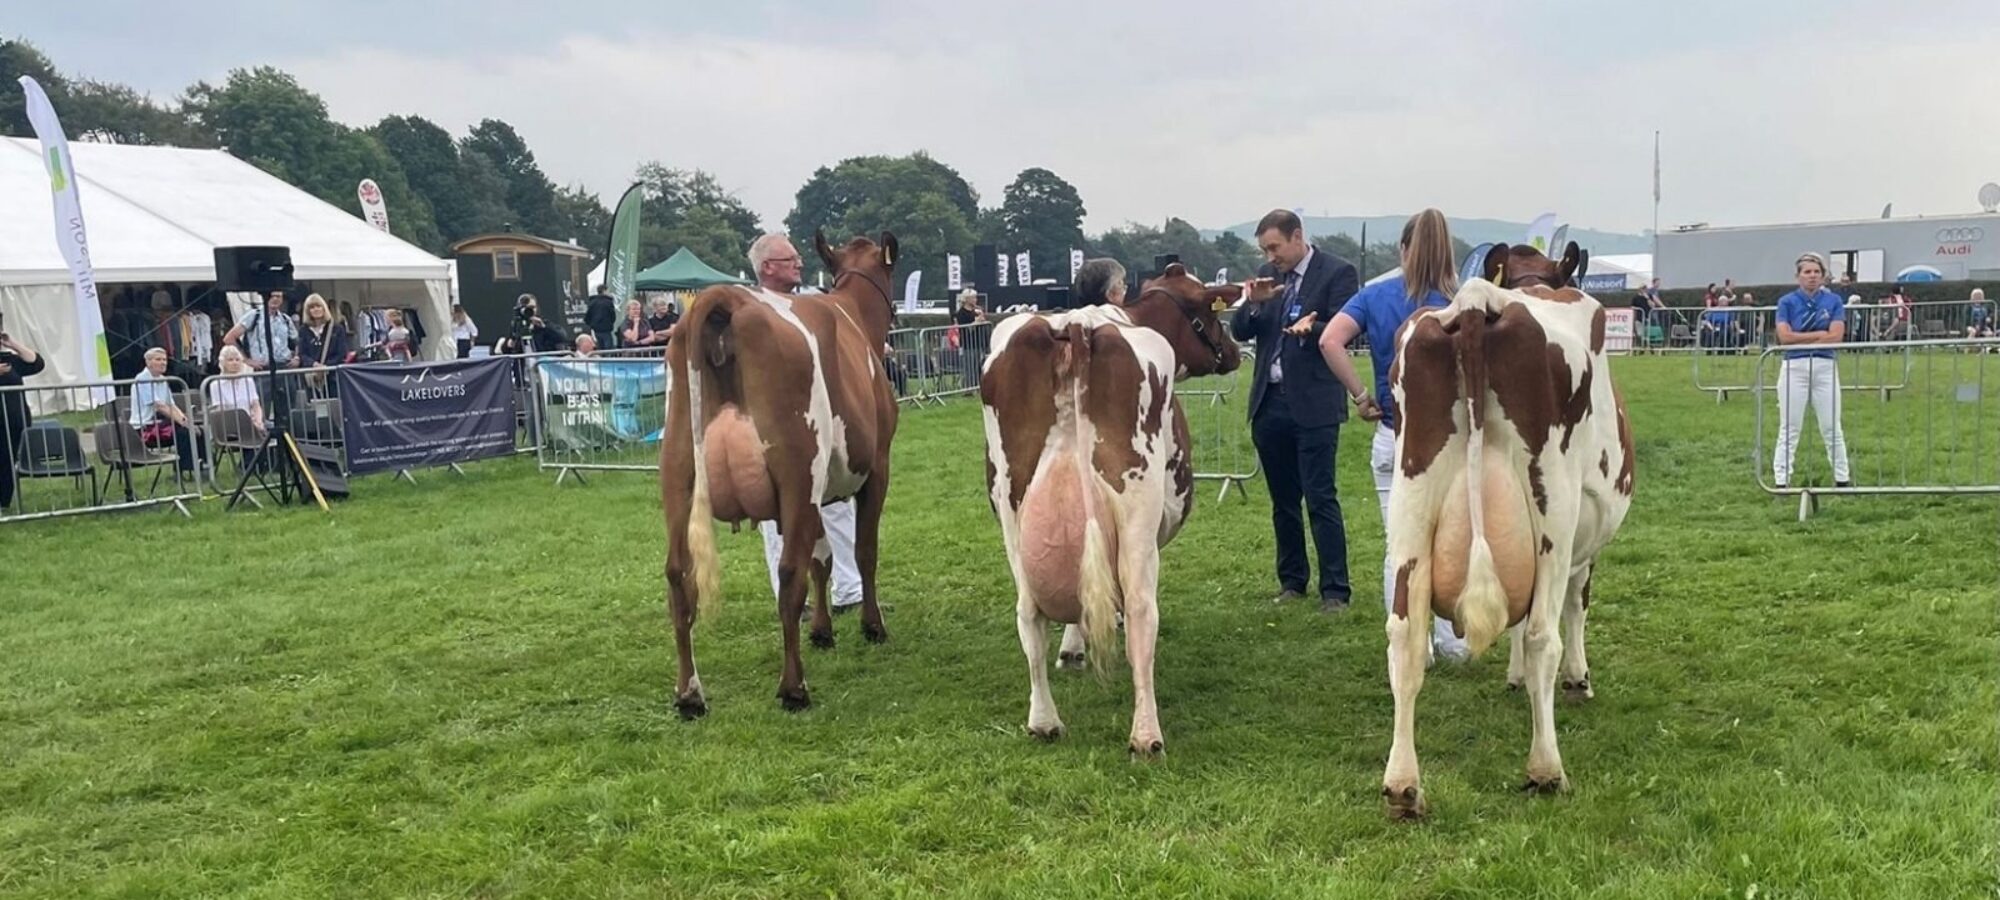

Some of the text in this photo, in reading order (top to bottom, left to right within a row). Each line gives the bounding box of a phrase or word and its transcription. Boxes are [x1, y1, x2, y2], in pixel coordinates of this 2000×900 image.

[1935, 244, 1972, 256] Audi
[401, 384, 466, 401] LAKELOVERS
[566, 394, 600, 409] BEATS
